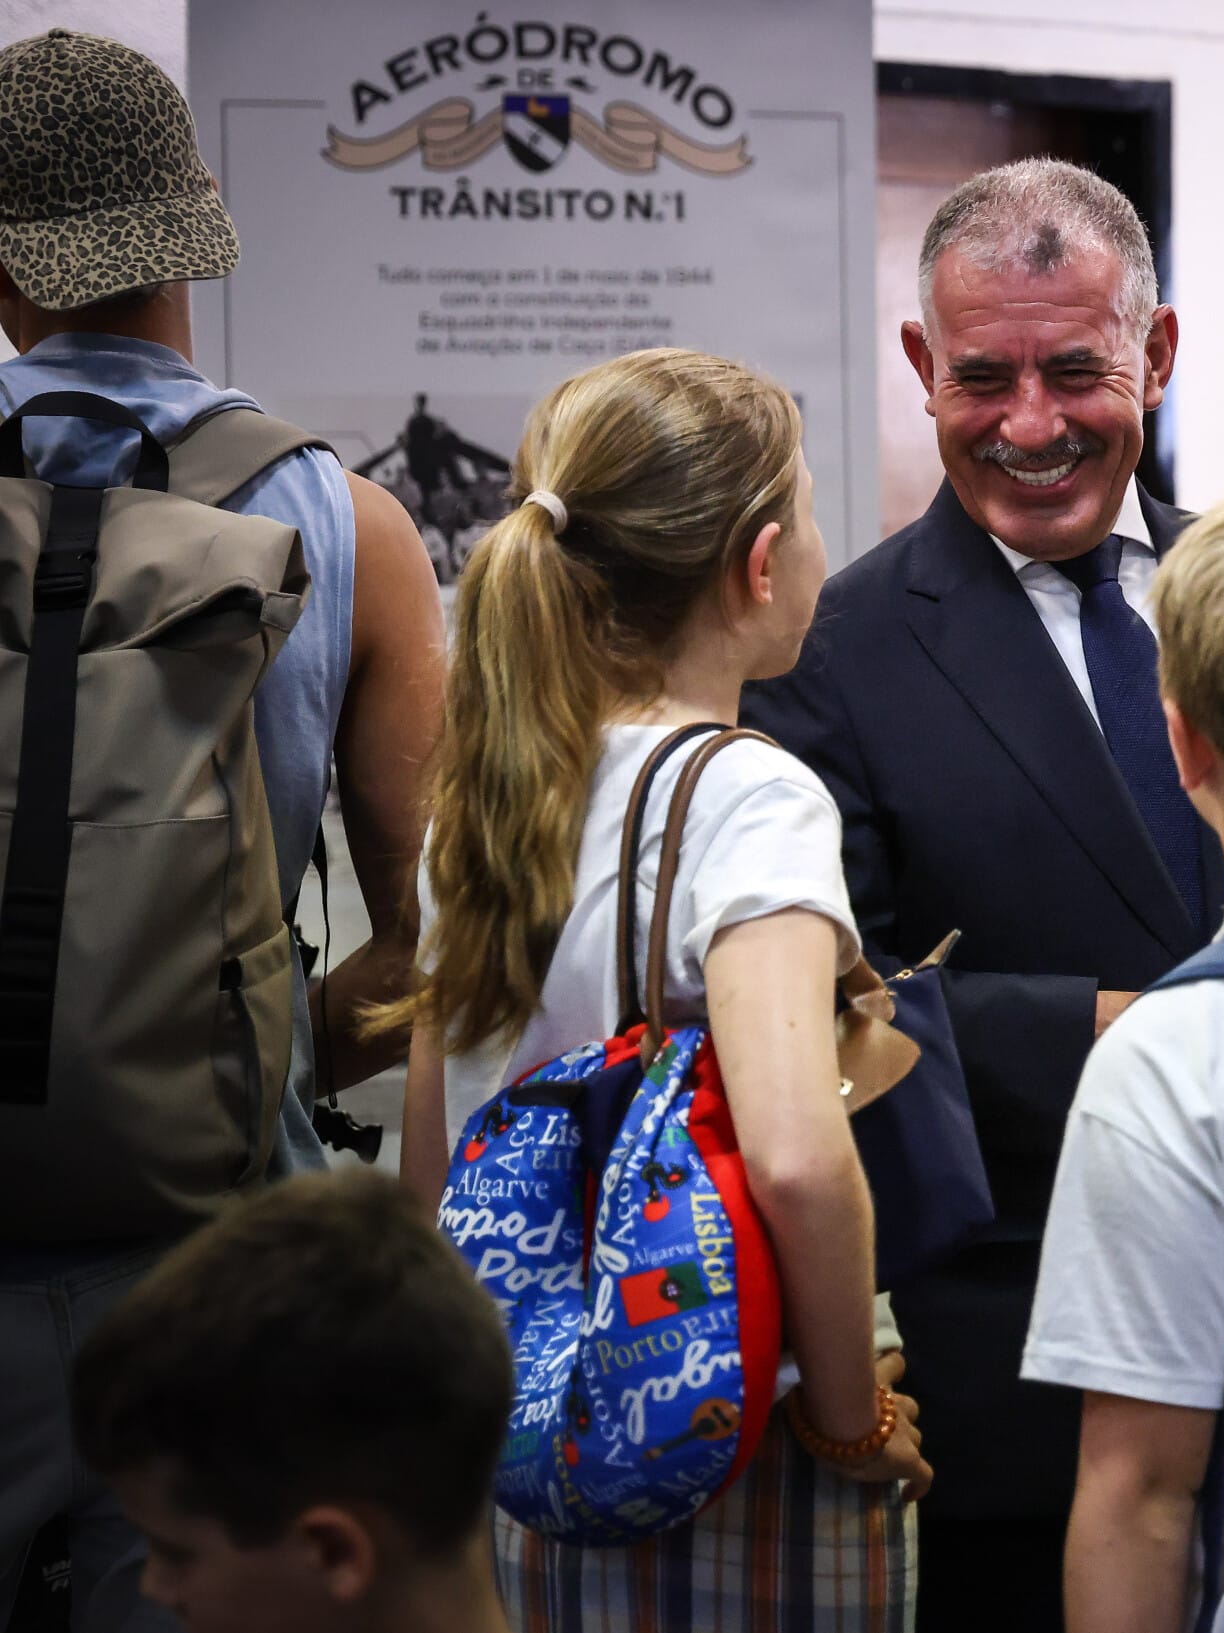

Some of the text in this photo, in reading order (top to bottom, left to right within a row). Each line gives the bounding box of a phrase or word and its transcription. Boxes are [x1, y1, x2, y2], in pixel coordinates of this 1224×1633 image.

[351, 12, 734, 130] AERÓDROMO
[516, 69, 555, 88] DE
[390, 177, 614, 221] TRÂNSITO
[455, 1167, 550, 1207] Algarve
[690, 1190, 733, 1297] Lisboa
[596, 1327, 684, 1376] Porto
